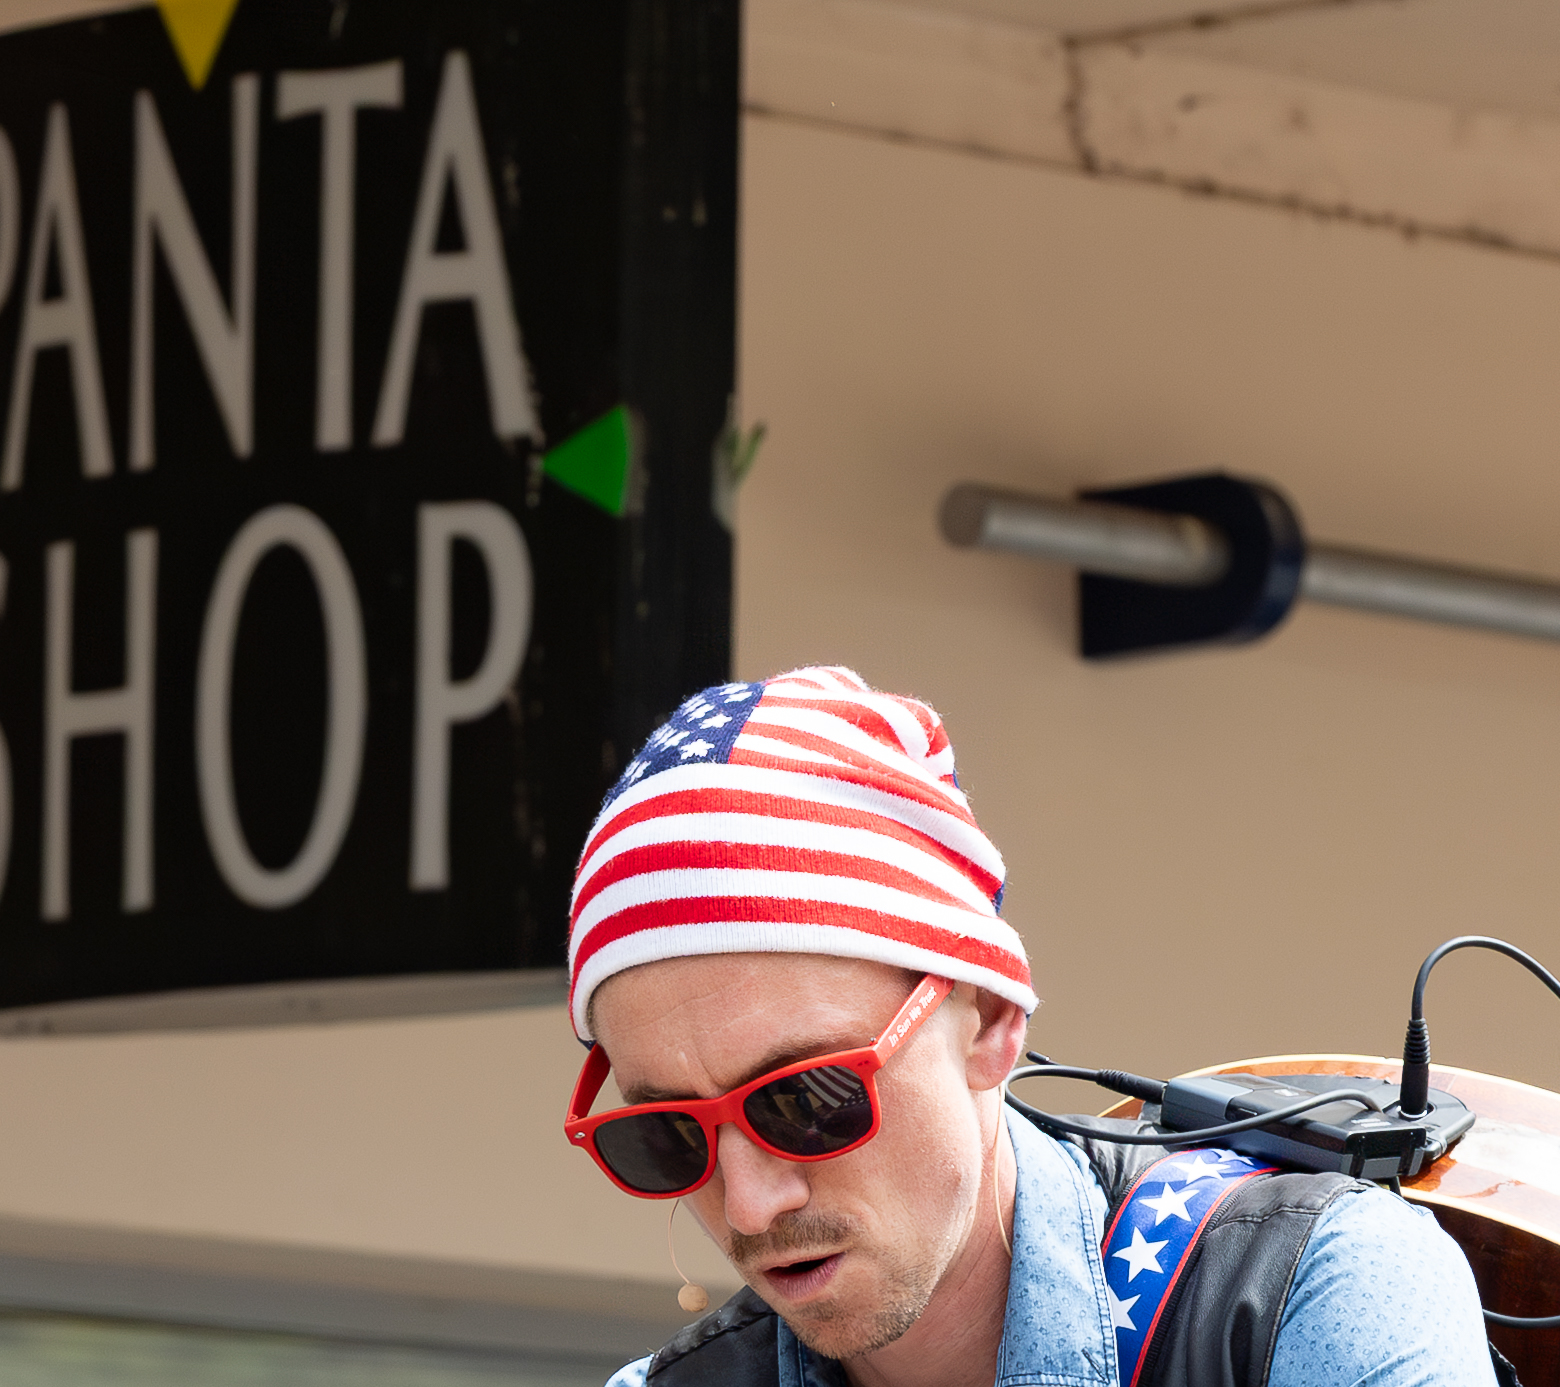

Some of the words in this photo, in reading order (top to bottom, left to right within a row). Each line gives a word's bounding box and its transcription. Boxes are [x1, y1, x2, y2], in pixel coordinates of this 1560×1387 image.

[888, 1033, 899, 1048] In
[896, 1018, 912, 1038] Sun
[918, 985, 937, 1009] Trust
